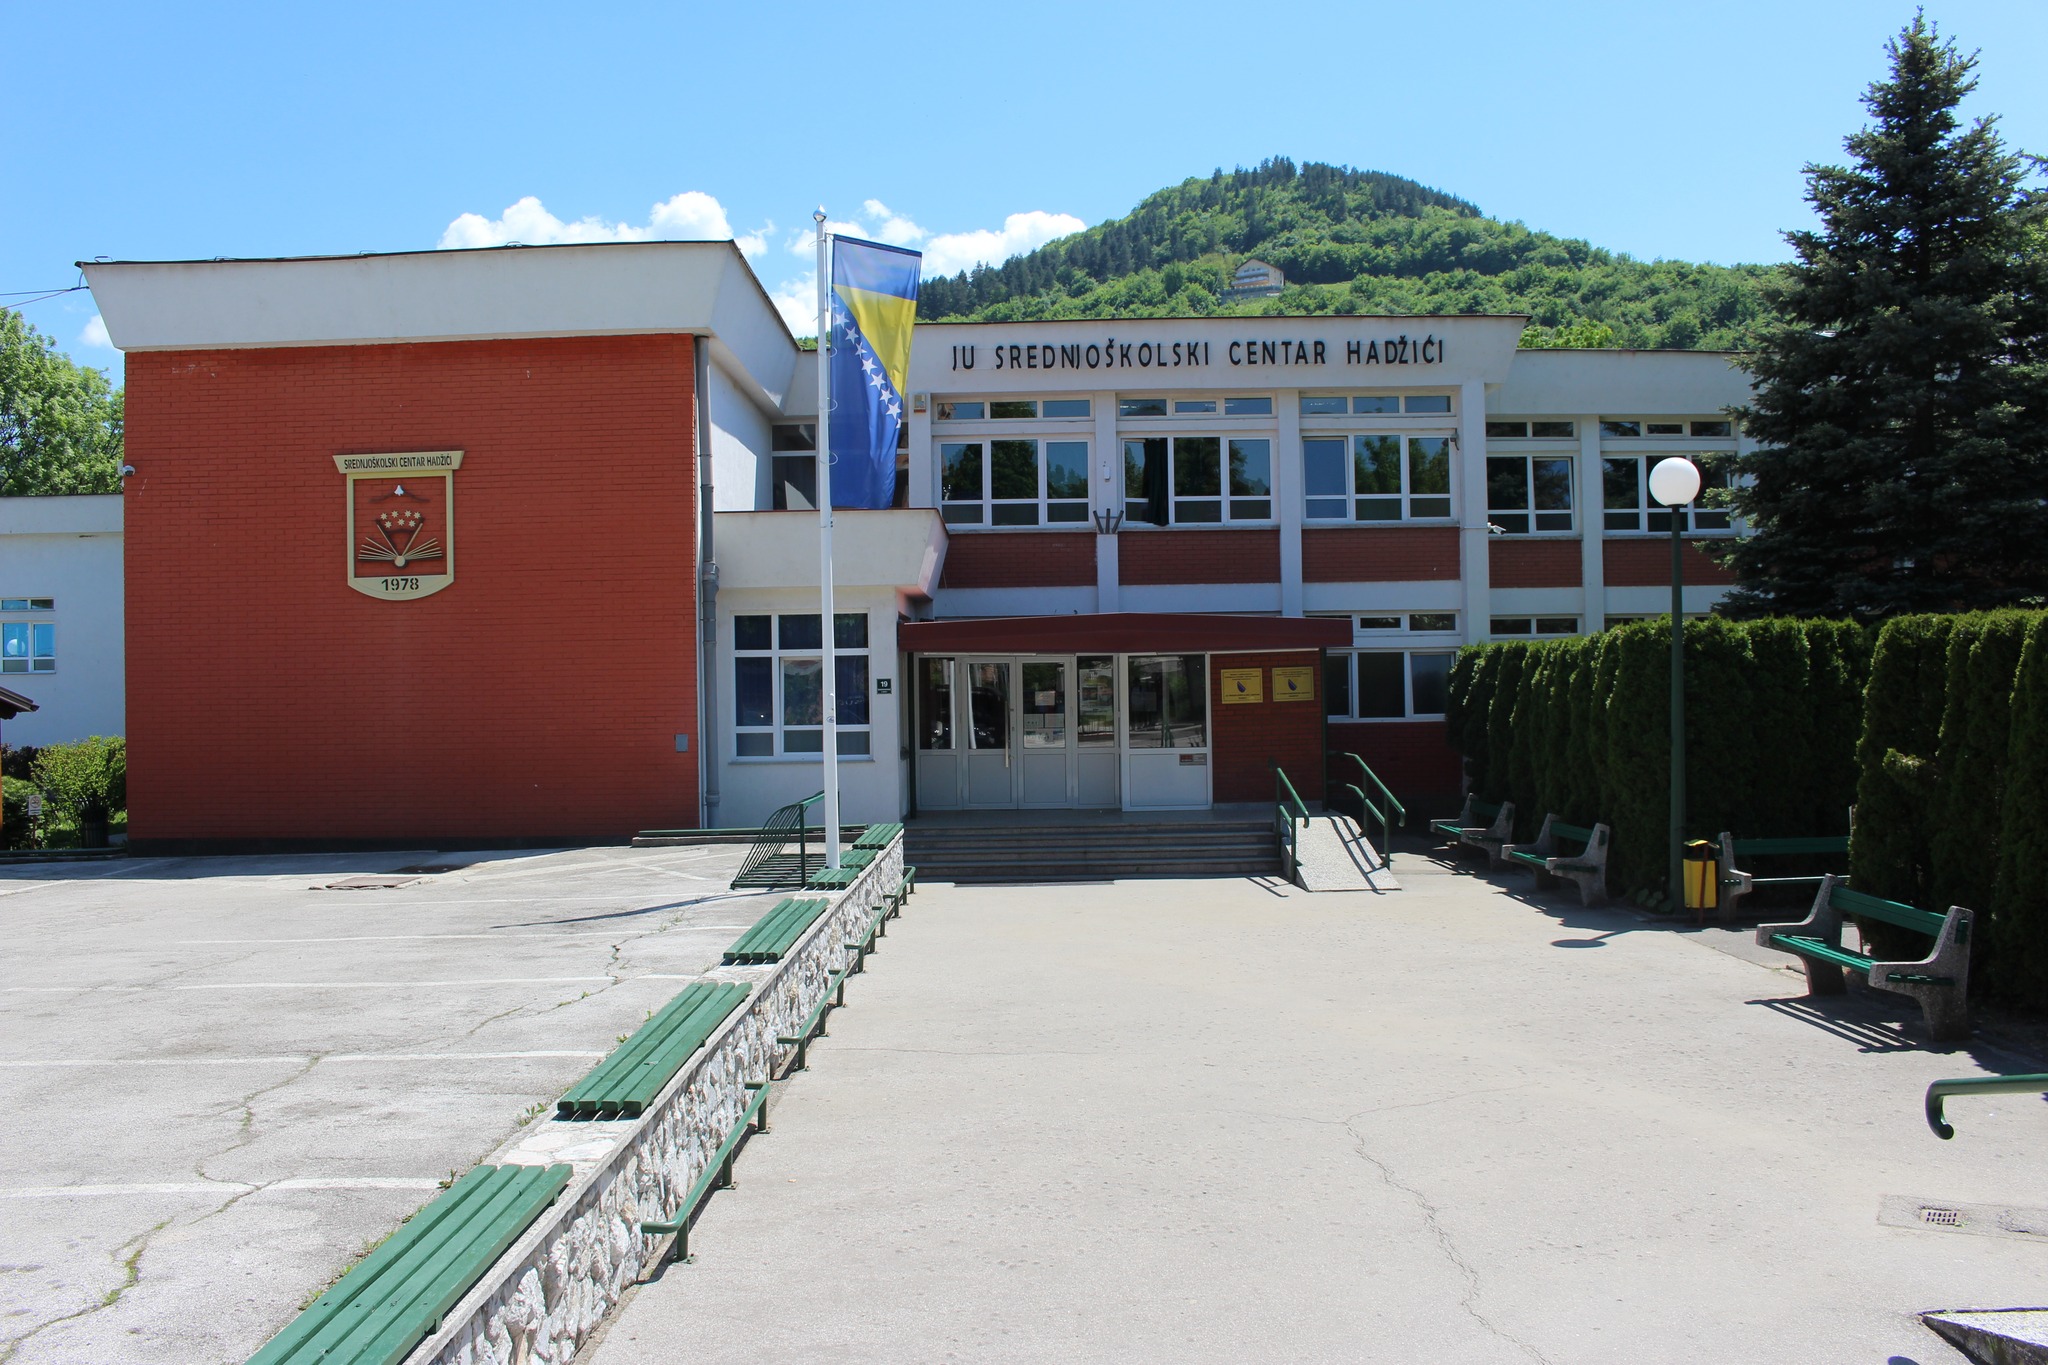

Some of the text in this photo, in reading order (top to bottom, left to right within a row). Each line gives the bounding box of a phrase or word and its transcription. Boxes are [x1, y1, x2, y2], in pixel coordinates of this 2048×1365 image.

[952, 334, 1442, 371] JU SREDNJOŠKOLSKI CENTAR HADŽIĆI
[344, 453, 452, 469] SREDNJOŠKOLSKI CENTAR HADŽIĆI
[381, 577, 419, 591] 1978
[880, 680, 888, 688] 19
